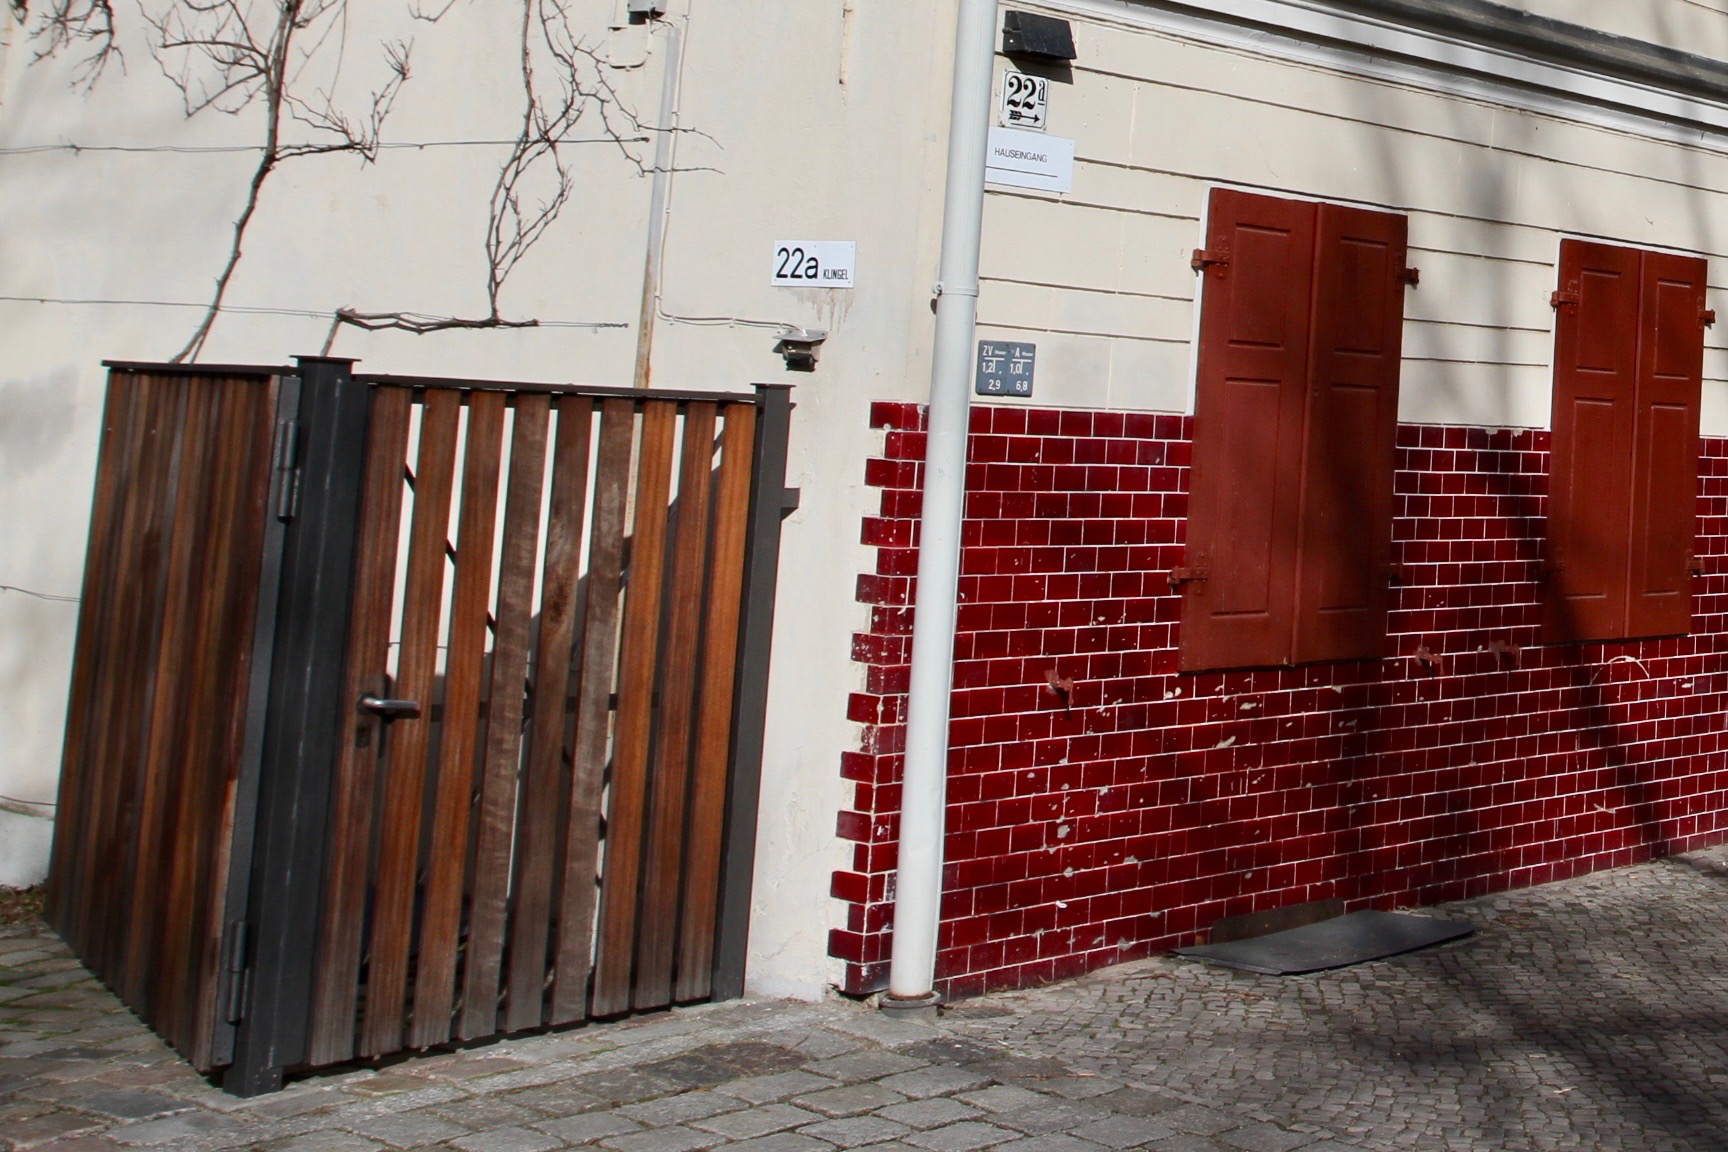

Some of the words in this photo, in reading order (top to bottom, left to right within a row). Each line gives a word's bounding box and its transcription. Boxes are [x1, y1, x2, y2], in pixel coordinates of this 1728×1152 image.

[1007, 75, 1045, 110] 22a
[994, 147, 1048, 163] HAUSEINGANG
[776, 247, 819, 280] 22a
[823, 268, 849, 280] KLINGEL
[988, 379, 1001, 390] 2,9
[1015, 380, 1028, 392] 6,8
